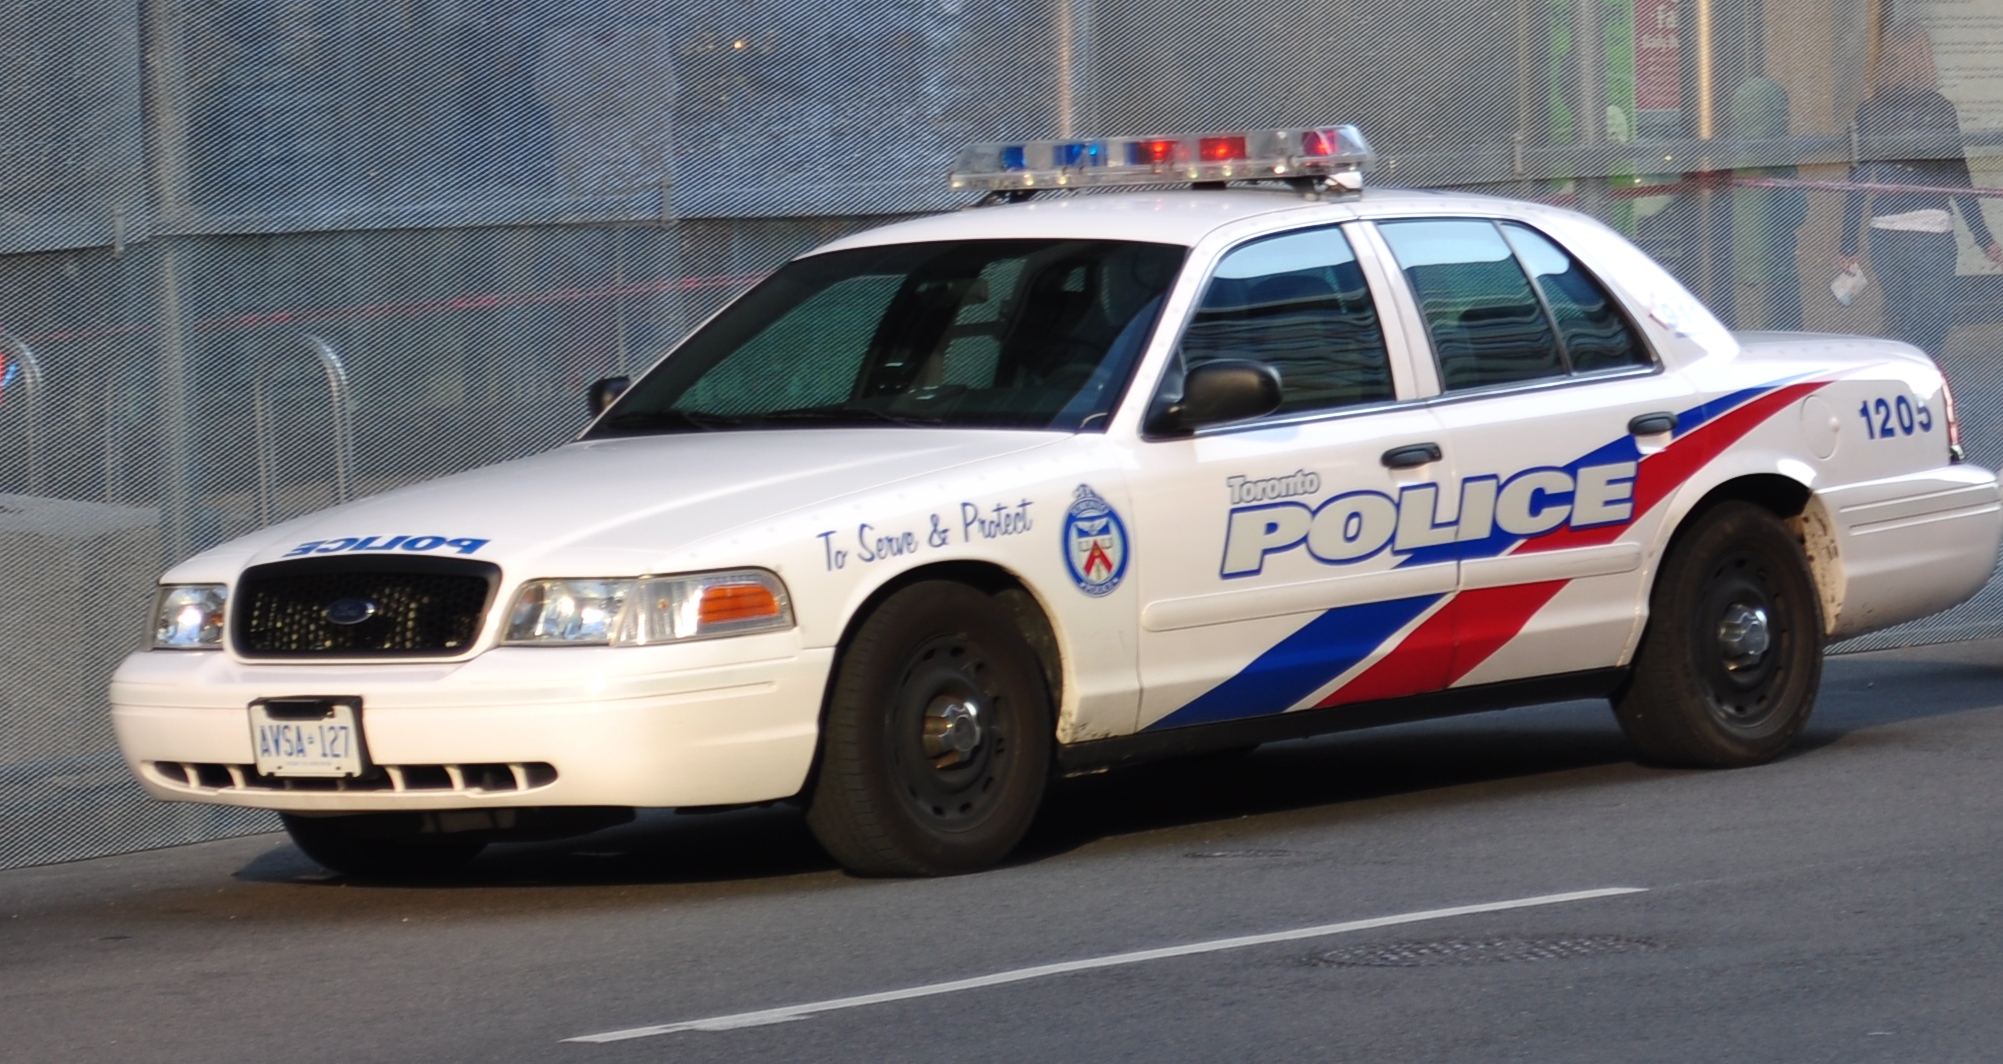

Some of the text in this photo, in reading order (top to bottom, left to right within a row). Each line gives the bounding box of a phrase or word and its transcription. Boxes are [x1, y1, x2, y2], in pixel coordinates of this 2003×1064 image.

[1859, 394, 1933, 440] 1205
[1227, 469, 1321, 505] Toronto
[816, 498, 1034, 572] To Serve & Protect
[1220, 460, 1637, 579] POLICE
[318, 724, 350, 758] 127
